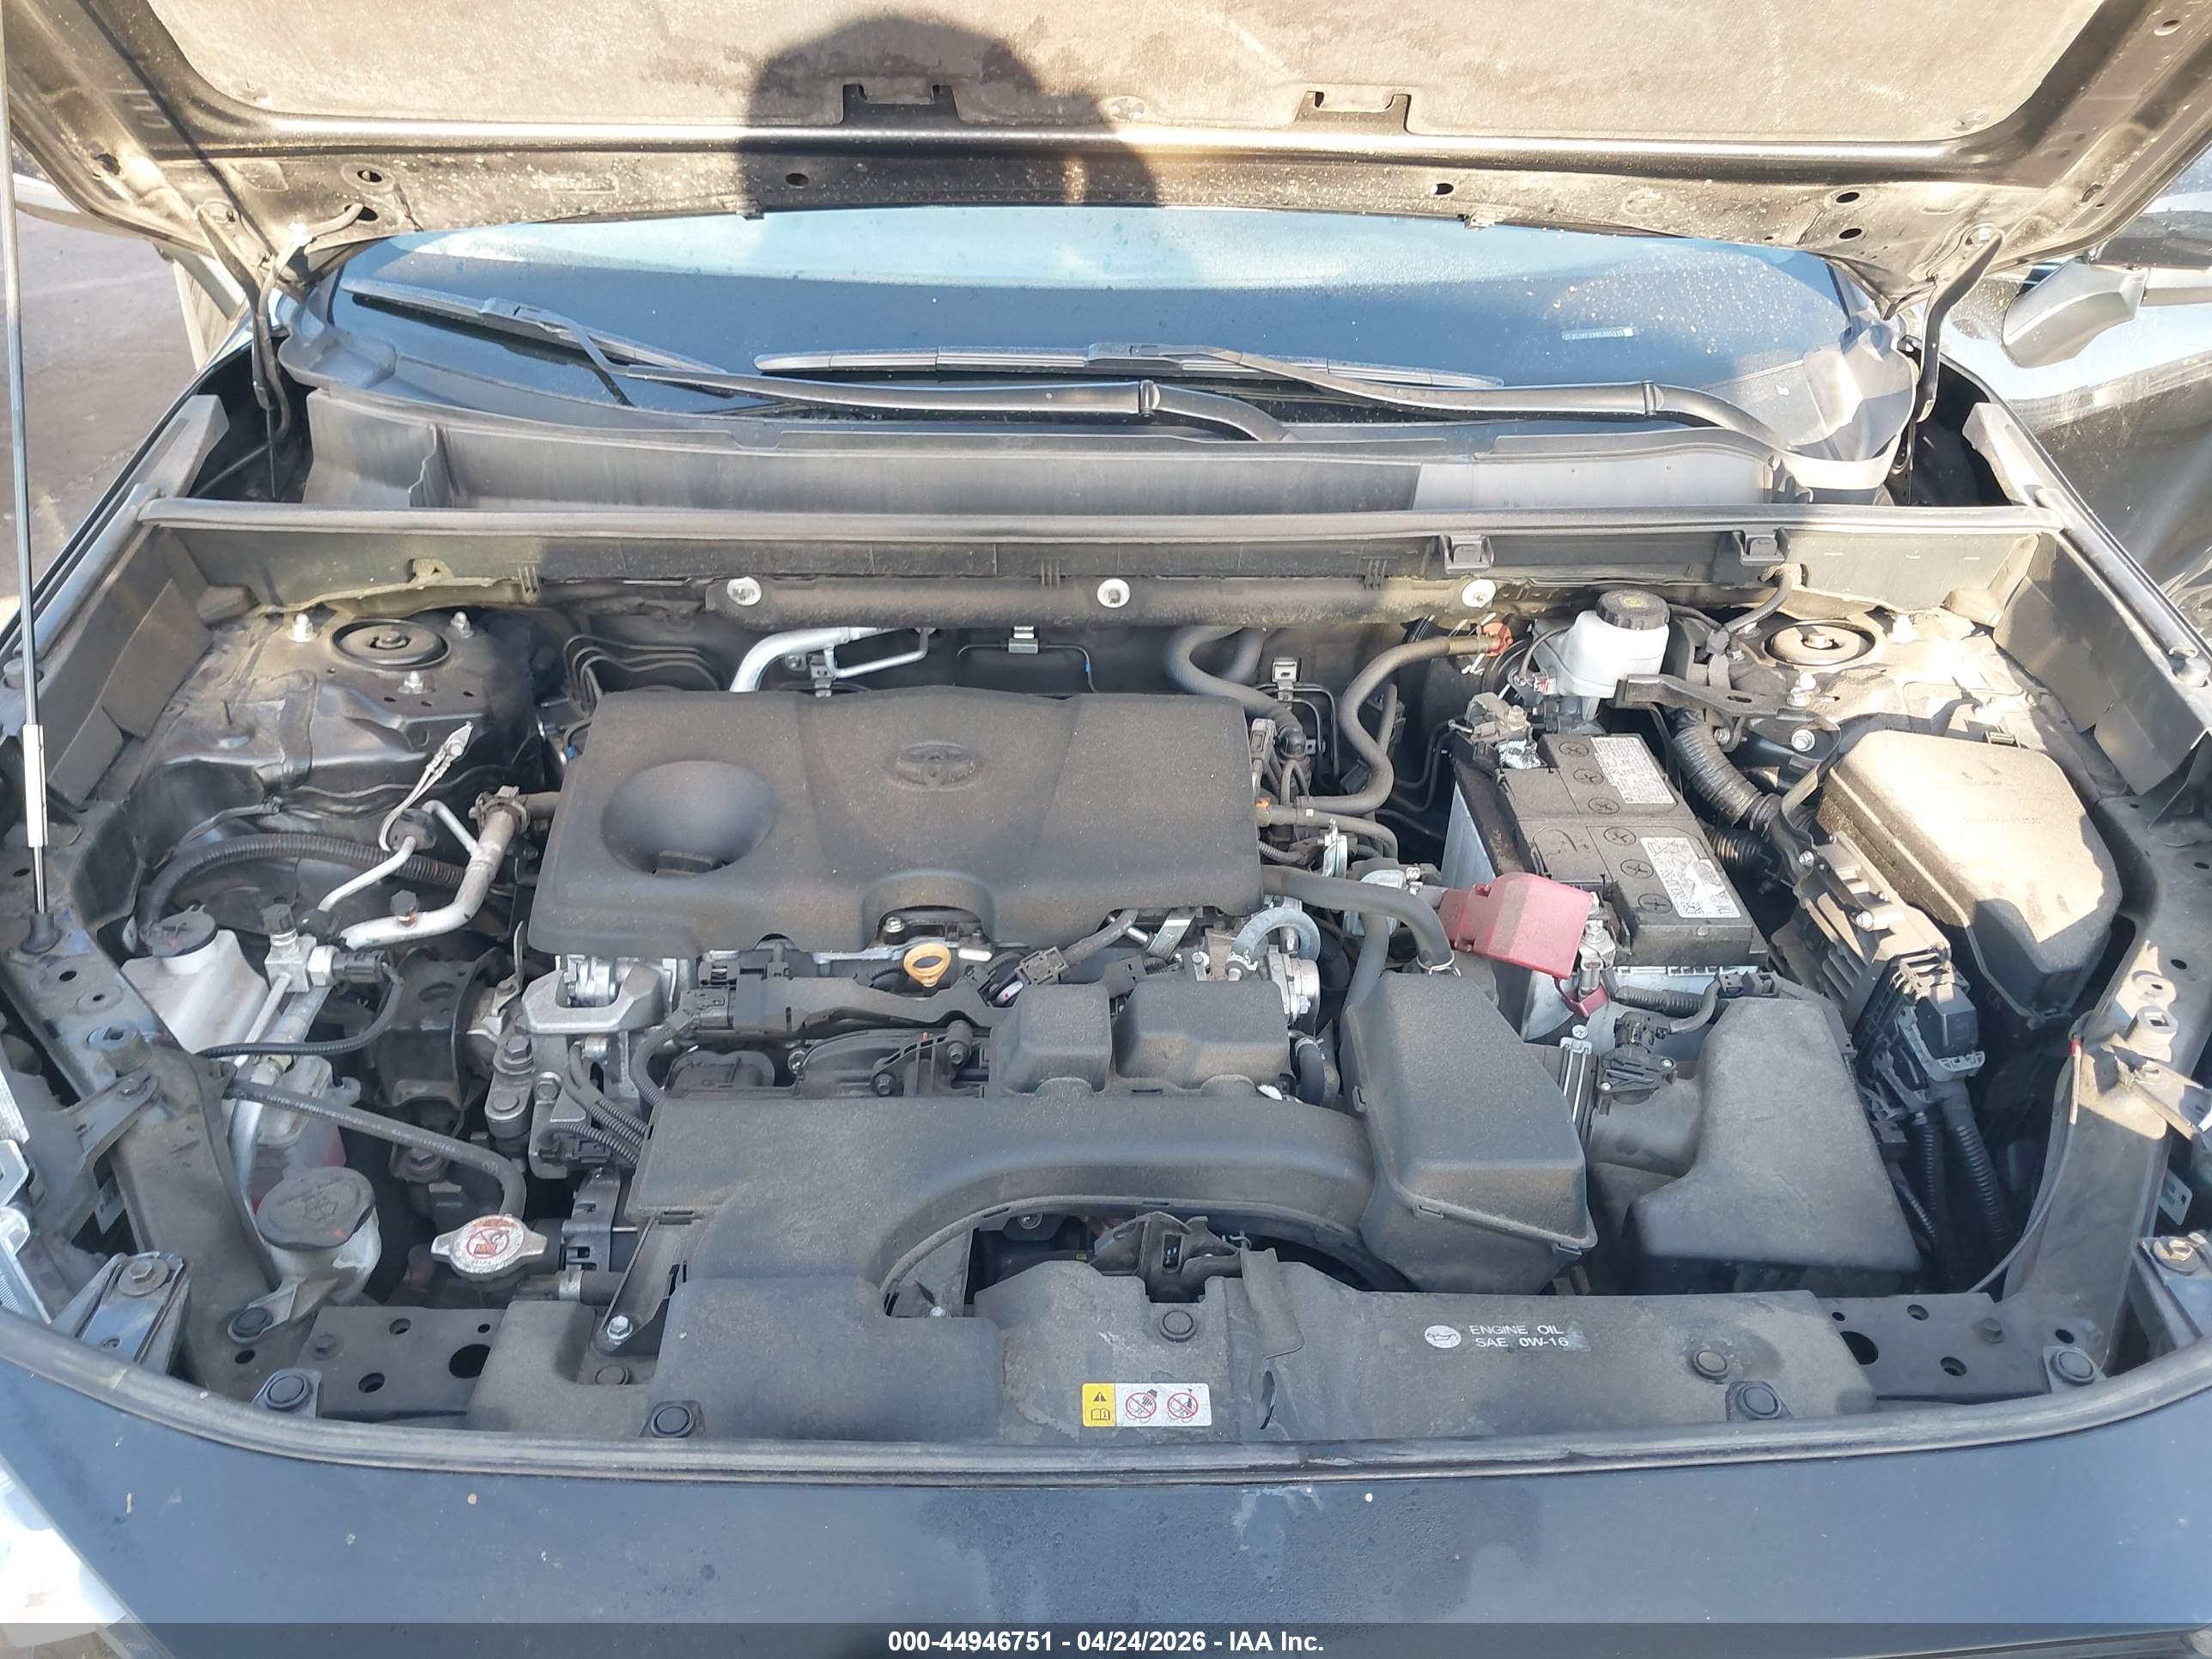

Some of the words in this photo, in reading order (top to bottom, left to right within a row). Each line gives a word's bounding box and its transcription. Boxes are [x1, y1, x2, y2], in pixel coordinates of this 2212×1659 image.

[1469, 1325, 1528, 1335] ENGINE
[1537, 1325, 1565, 1335] OIL
[1475, 1337, 1509, 1348] SAE
[1519, 1337, 1570, 1347] 0W-16
